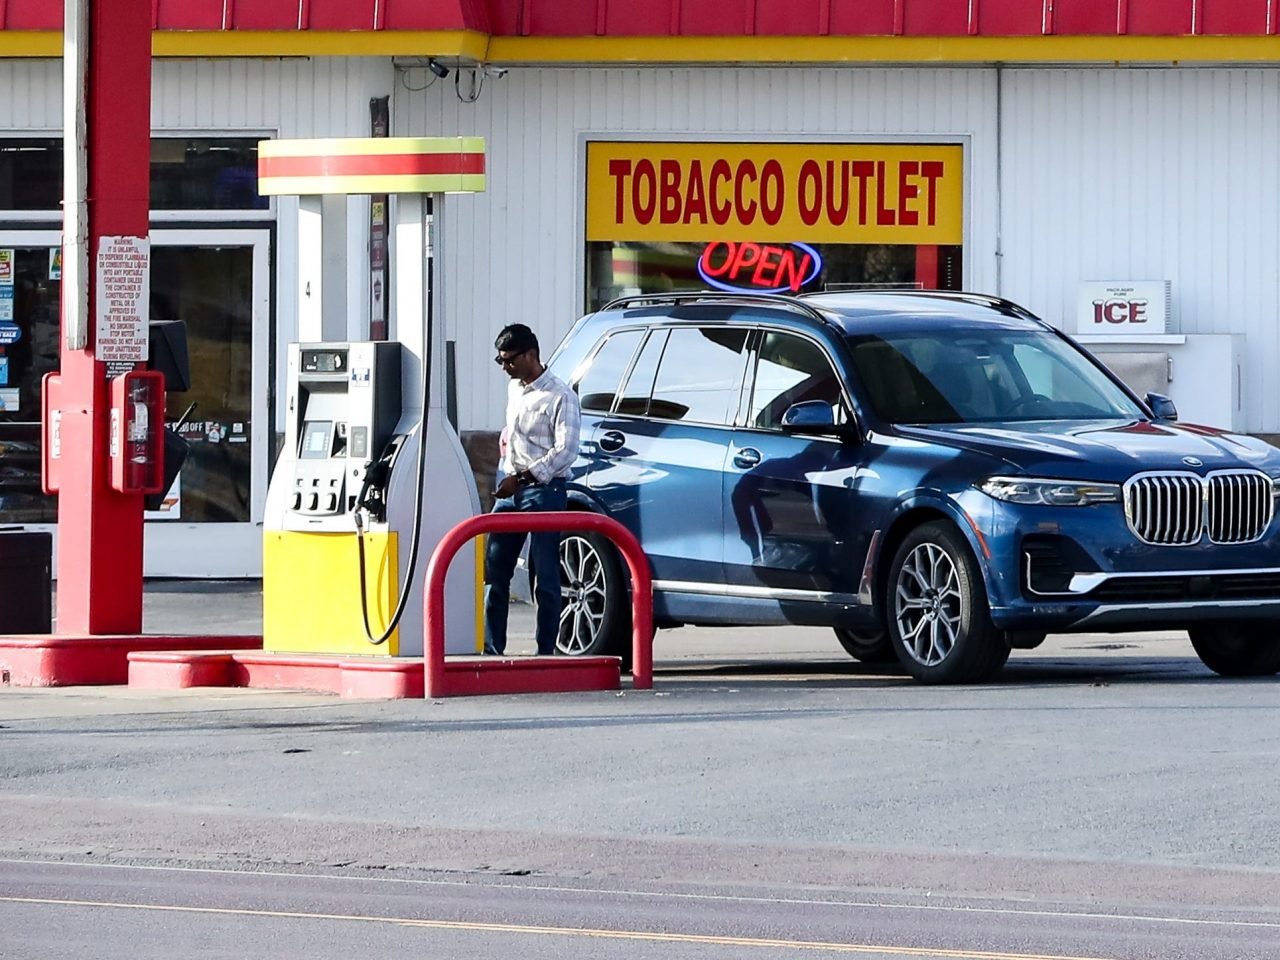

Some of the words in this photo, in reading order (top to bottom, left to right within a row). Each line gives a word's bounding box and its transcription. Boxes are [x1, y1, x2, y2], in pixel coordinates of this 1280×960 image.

[609, 158, 784, 226] TOBACCO
[800, 159, 944, 227] OUTLET
[701, 241, 810, 290] OPEN
[1092, 298, 1149, 324] ICE
